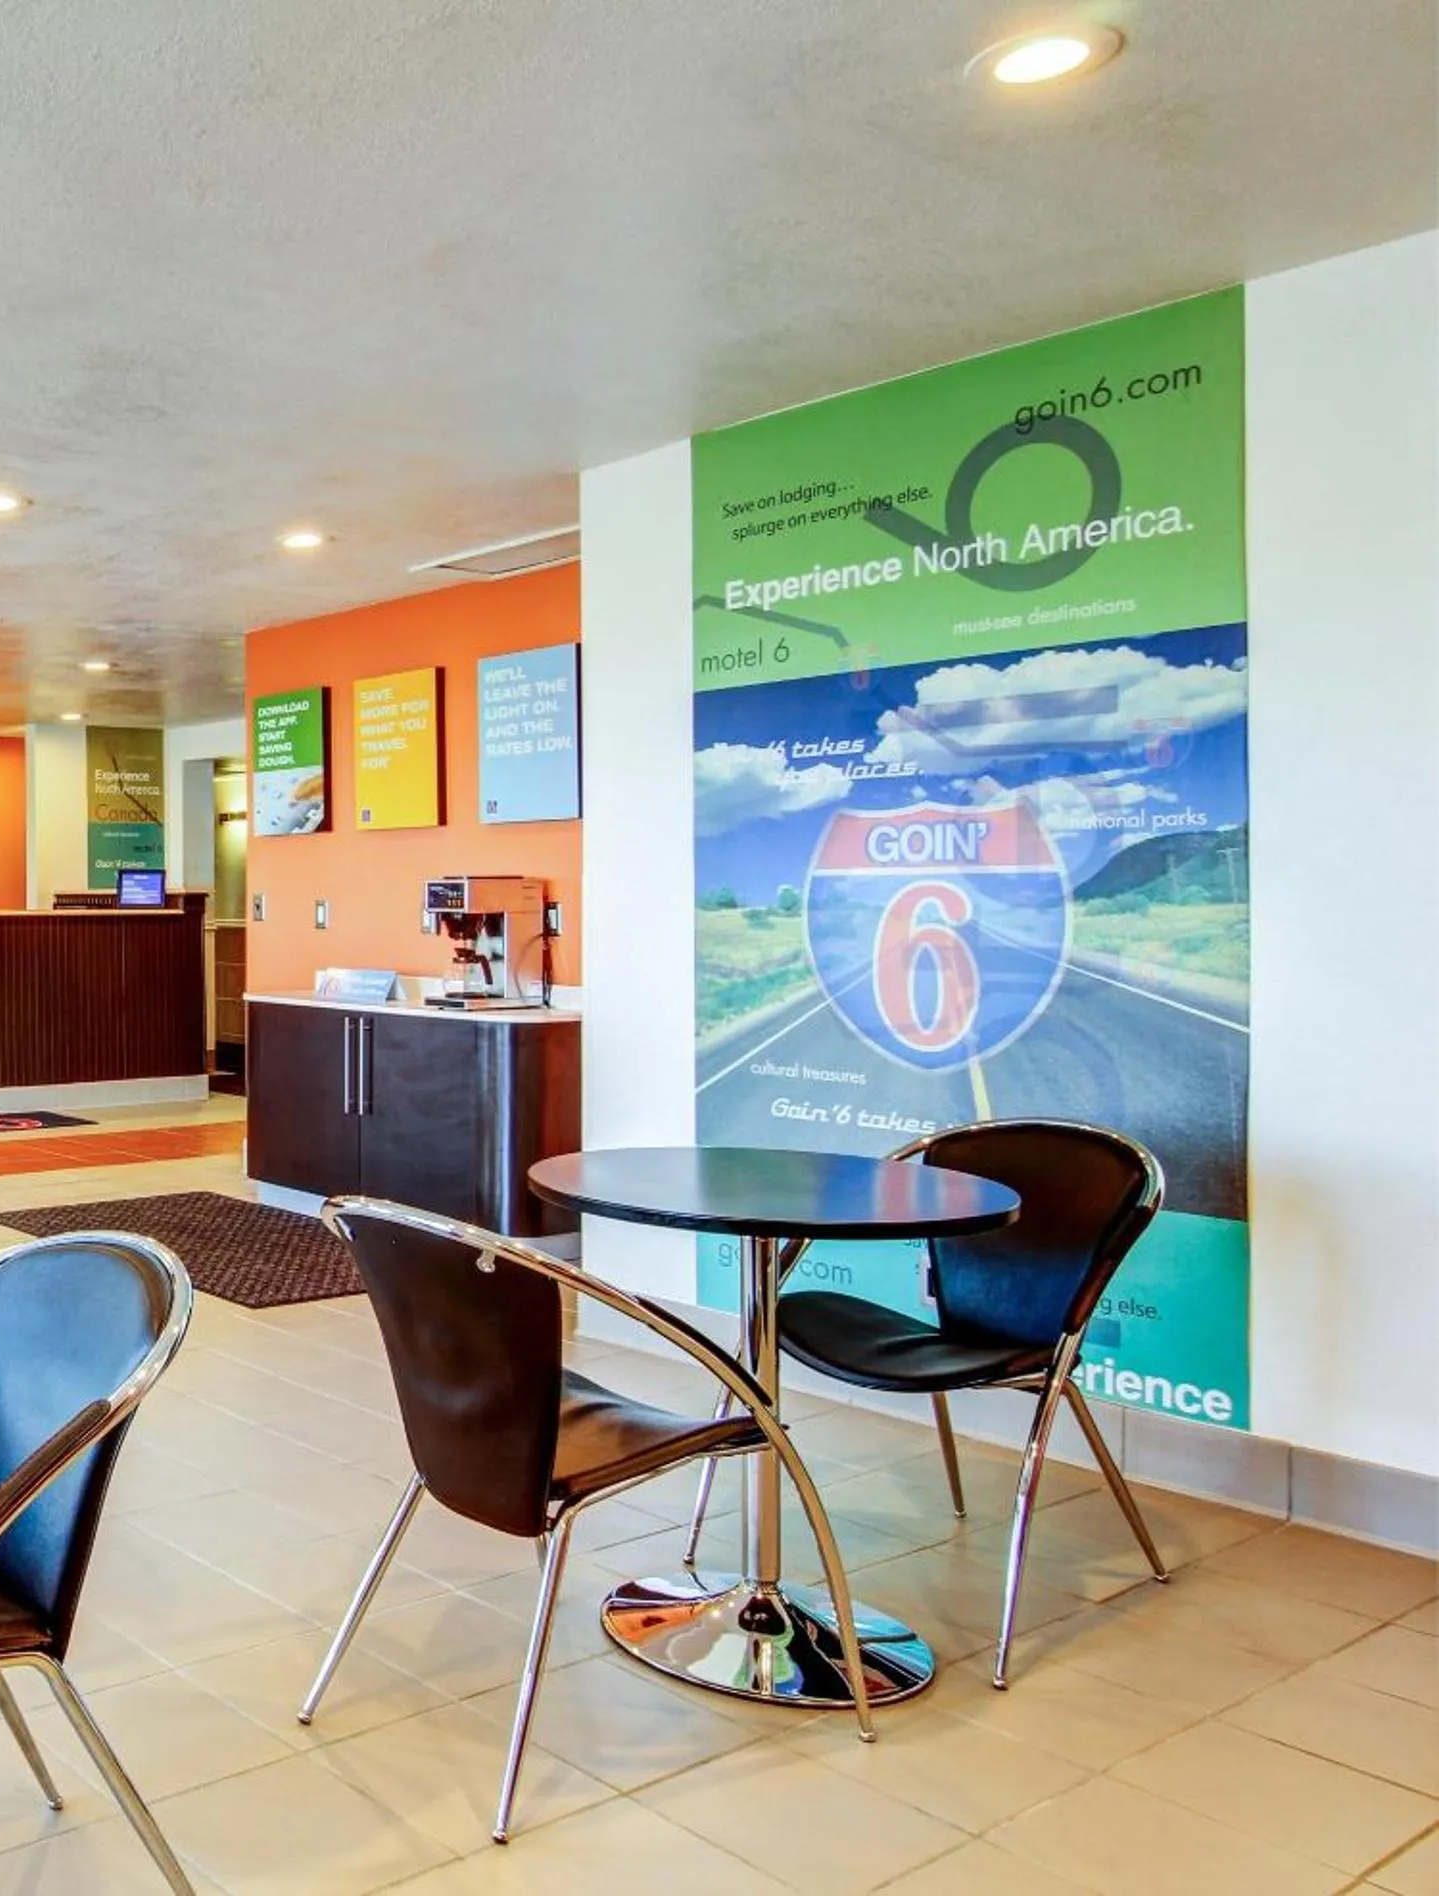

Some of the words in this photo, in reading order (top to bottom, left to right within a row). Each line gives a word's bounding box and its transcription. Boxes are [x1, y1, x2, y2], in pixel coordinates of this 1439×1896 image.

[1015, 365, 1201, 434] goin6.com
[722, 502, 756, 519] Save
[757, 495, 776, 510] on
[732, 517, 786, 541] splurge
[788, 512, 807, 528] on
[810, 494, 893, 523] everything
[896, 486, 933, 504] else.
[724, 553, 903, 612] Experience
[913, 527, 1008, 577] North
[1019, 504, 1195, 560] America.
[1027, 599, 1137, 625] destinations
[700, 637, 763, 674] motel
[773, 637, 791, 664] 6
[360, 688, 394, 704] SAVE
[485, 684, 532, 703] LEAVE
[534, 677, 568, 696] THE
[258, 700, 310, 717] DOWNLOAD
[360, 704, 399, 720] MORE
[401, 698, 430, 714] FOR
[484, 702, 528, 721] LIGHT
[258, 719, 276, 730] THE
[258, 730, 286, 743] START
[360, 720, 396, 737] WHAT
[400, 716, 428, 732] YOU
[485, 722, 518, 741] AND
[521, 719, 555, 735] THE
[258, 742, 292, 755] SAVING
[486, 740, 533, 756] RATES
[791, 735, 866, 759] takes
[95, 769, 150, 782] Experience
[95, 783, 120, 794] North
[95, 804, 159, 821] Canada
[1070, 808, 1145, 830] national
[1152, 805, 1208, 832] parks
[867, 820, 988, 865] GOIN'
[873, 879, 980, 1054] 6
[750, 1059, 799, 1078] cultural
[802, 1062, 867, 1085] treasures
[770, 1097, 850, 1124] Goin'6
[856, 1109, 936, 1134] takes
[1118, 1297, 1162, 1321] else.
[1071, 1357, 1232, 1421] rience
